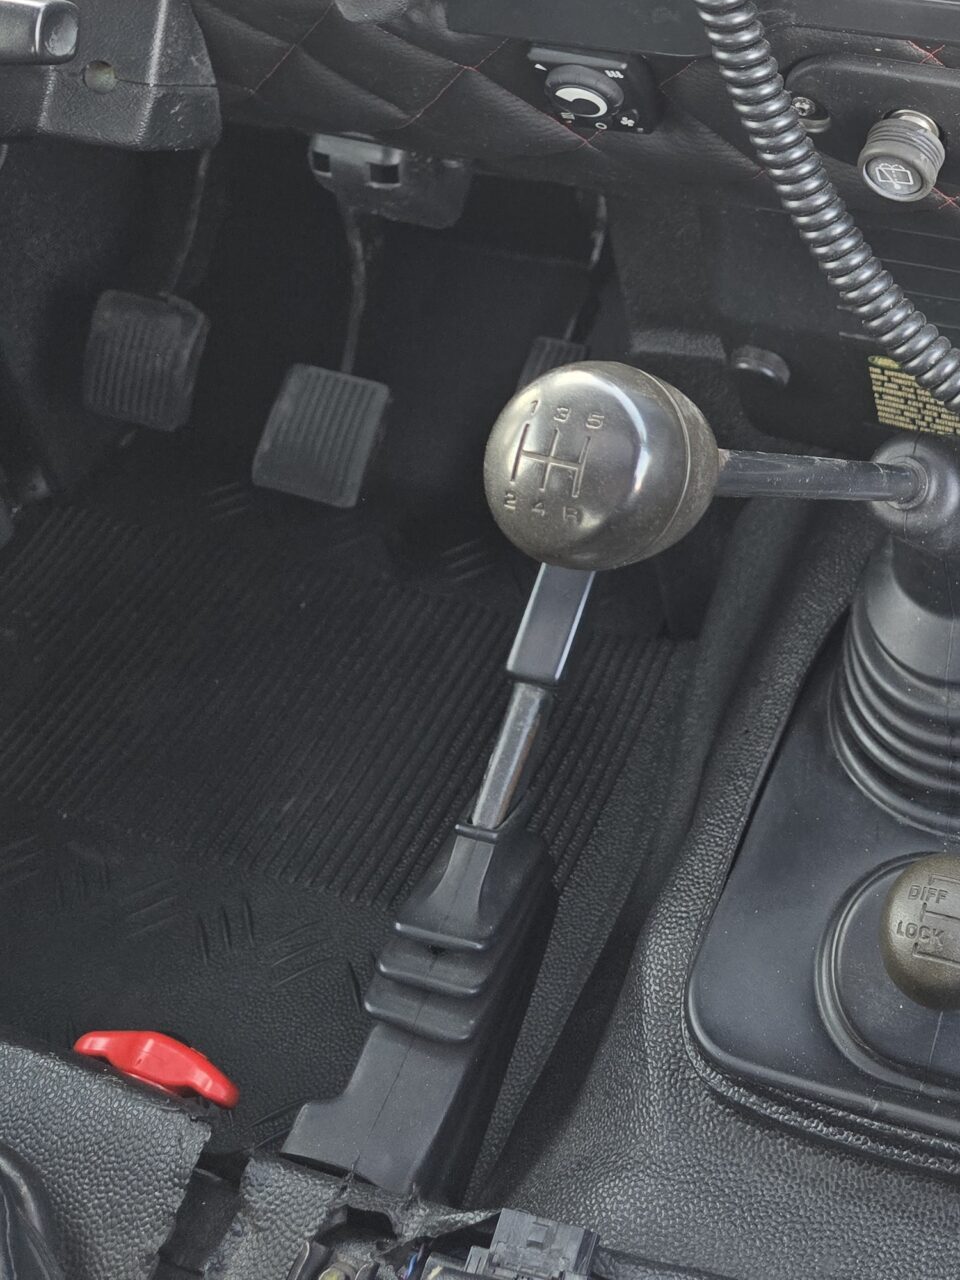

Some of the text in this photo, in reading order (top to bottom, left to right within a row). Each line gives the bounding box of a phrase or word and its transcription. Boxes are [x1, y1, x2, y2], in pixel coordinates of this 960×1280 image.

[553, 407, 571, 423] 3
[586, 412, 605, 430] 5
[504, 491, 517, 511] 2
[531, 501, 546, 518] 4
[907, 884, 949, 904] DIFF
[896, 920, 945, 946] LOCK
